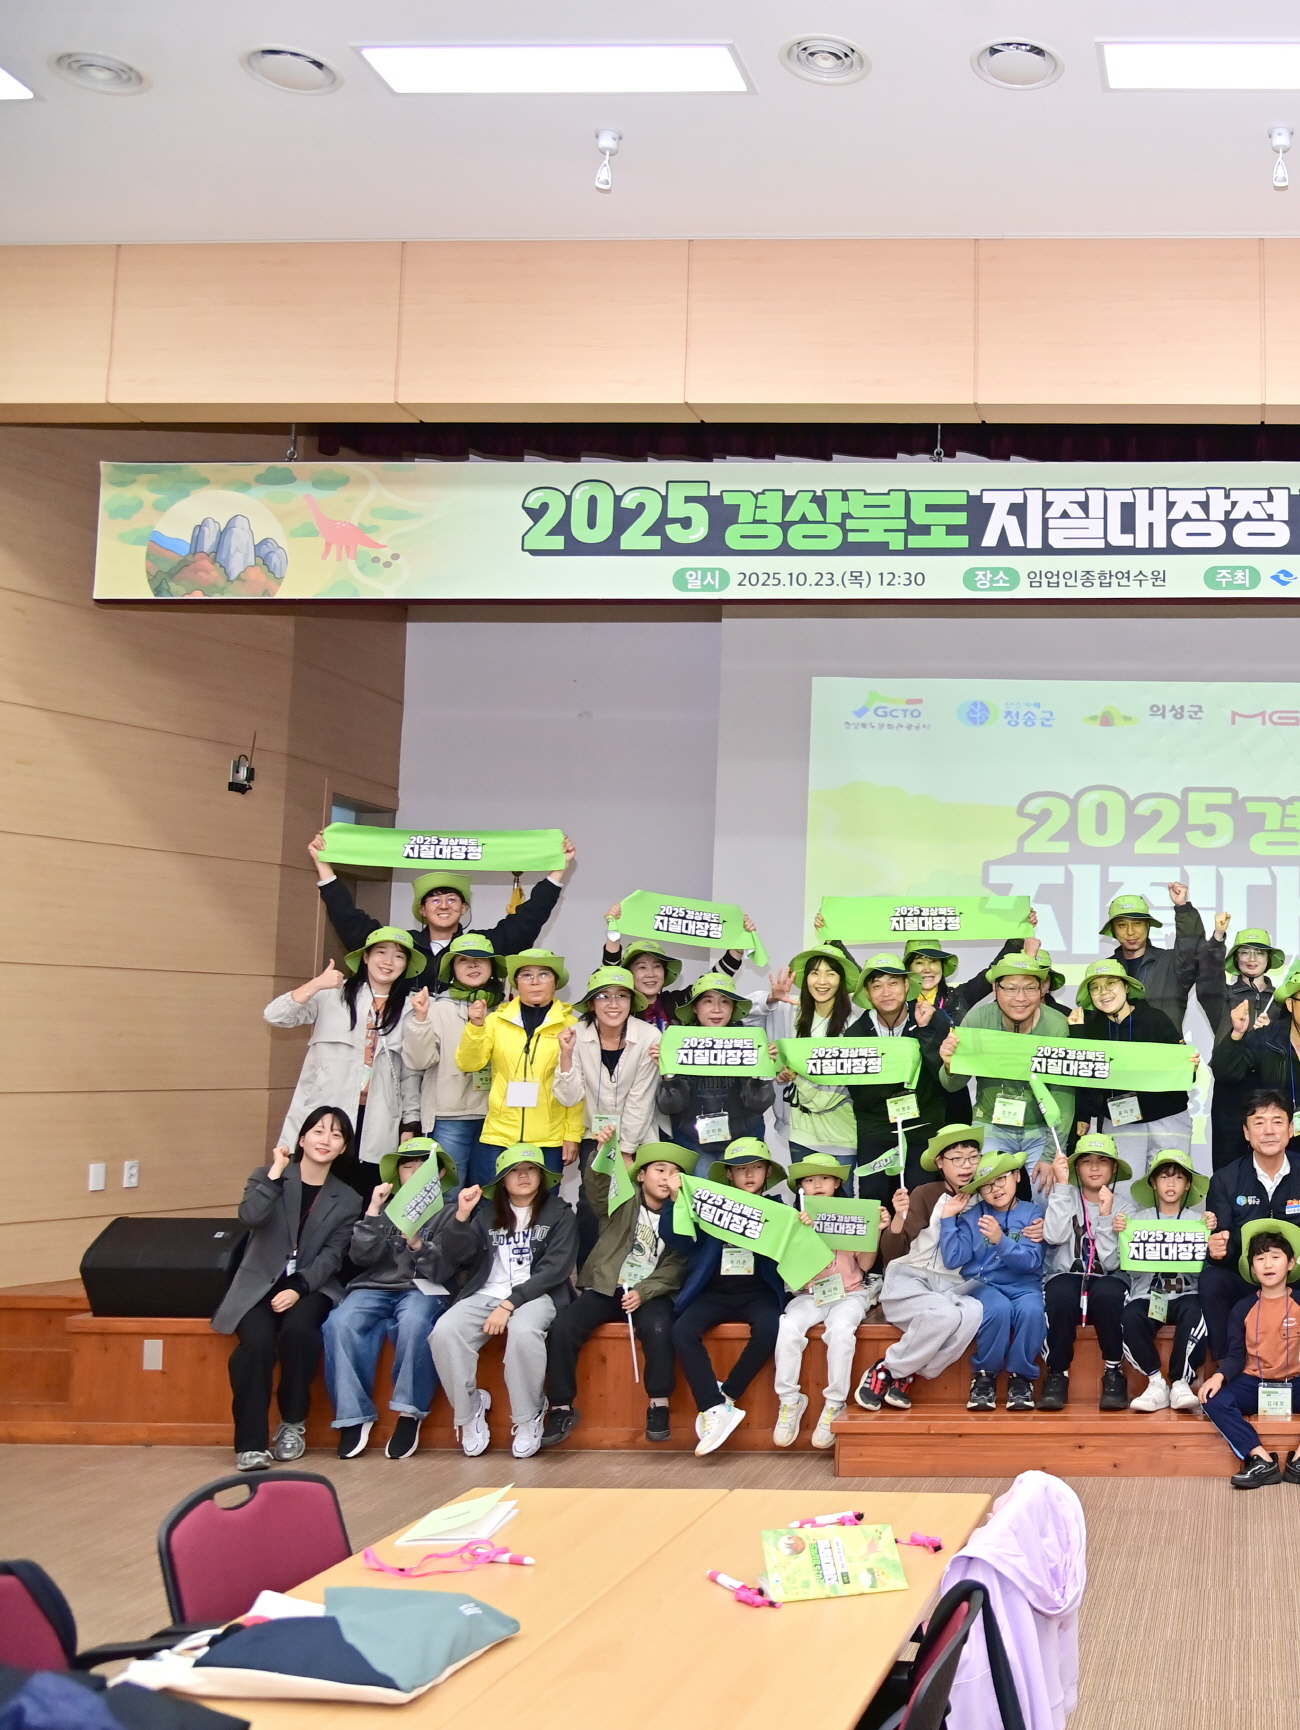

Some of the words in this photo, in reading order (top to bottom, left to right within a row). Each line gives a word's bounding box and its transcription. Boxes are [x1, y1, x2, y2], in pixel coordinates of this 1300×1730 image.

[523, 481, 711, 552] 2025
[722, 490, 971, 551] 경상북도
[980, 488, 1291, 549] 지질대장정
[684, 569, 721, 589] 일시
[737, 570, 872, 589] 2025.10.23.(목)
[878, 571, 926, 587] 12:30
[974, 570, 1011, 589] 장소
[1026, 569, 1167, 589] 임업인종합연수원
[1214, 568, 1250, 588] 주최
[873, 705, 922, 719] GCTO
[1003, 709, 1056, 728] 청송군
[1149, 703, 1204, 720] 의성군
[1230, 710, 1300, 726] MG
[1017, 788, 1236, 855] 2025
[410, 835, 439, 845] 2025
[439, 838, 479, 846] 경상북도
[403, 845, 483, 860] 지질대장정
[660, 905, 686, 918] 2025
[685, 909, 720, 923] 경상북도
[894, 905, 920, 917] 2025
[920, 907, 956, 917] 경상북도
[653, 914, 723, 939] 지질대장정
[889, 915, 960, 931] 지질대장정
[682, 1037, 713, 1049] 2025
[712, 1038, 754, 1049] 경상북도
[677, 1047, 758, 1066] 지질대장정
[811, 1046, 839, 1059] 2025
[839, 1047, 878, 1058] 경상북도
[1037, 1046, 1067, 1060] 2025
[1066, 1049, 1106, 1062] 경상북도
[806, 1056, 882, 1075] 지질대장정
[1030, 1055, 1110, 1079] 지질대장정
[1133, 1230, 1164, 1242] 2025
[1163, 1231, 1206, 1242] 경상북도
[1128, 1241, 1208, 1261] 지질대장정
